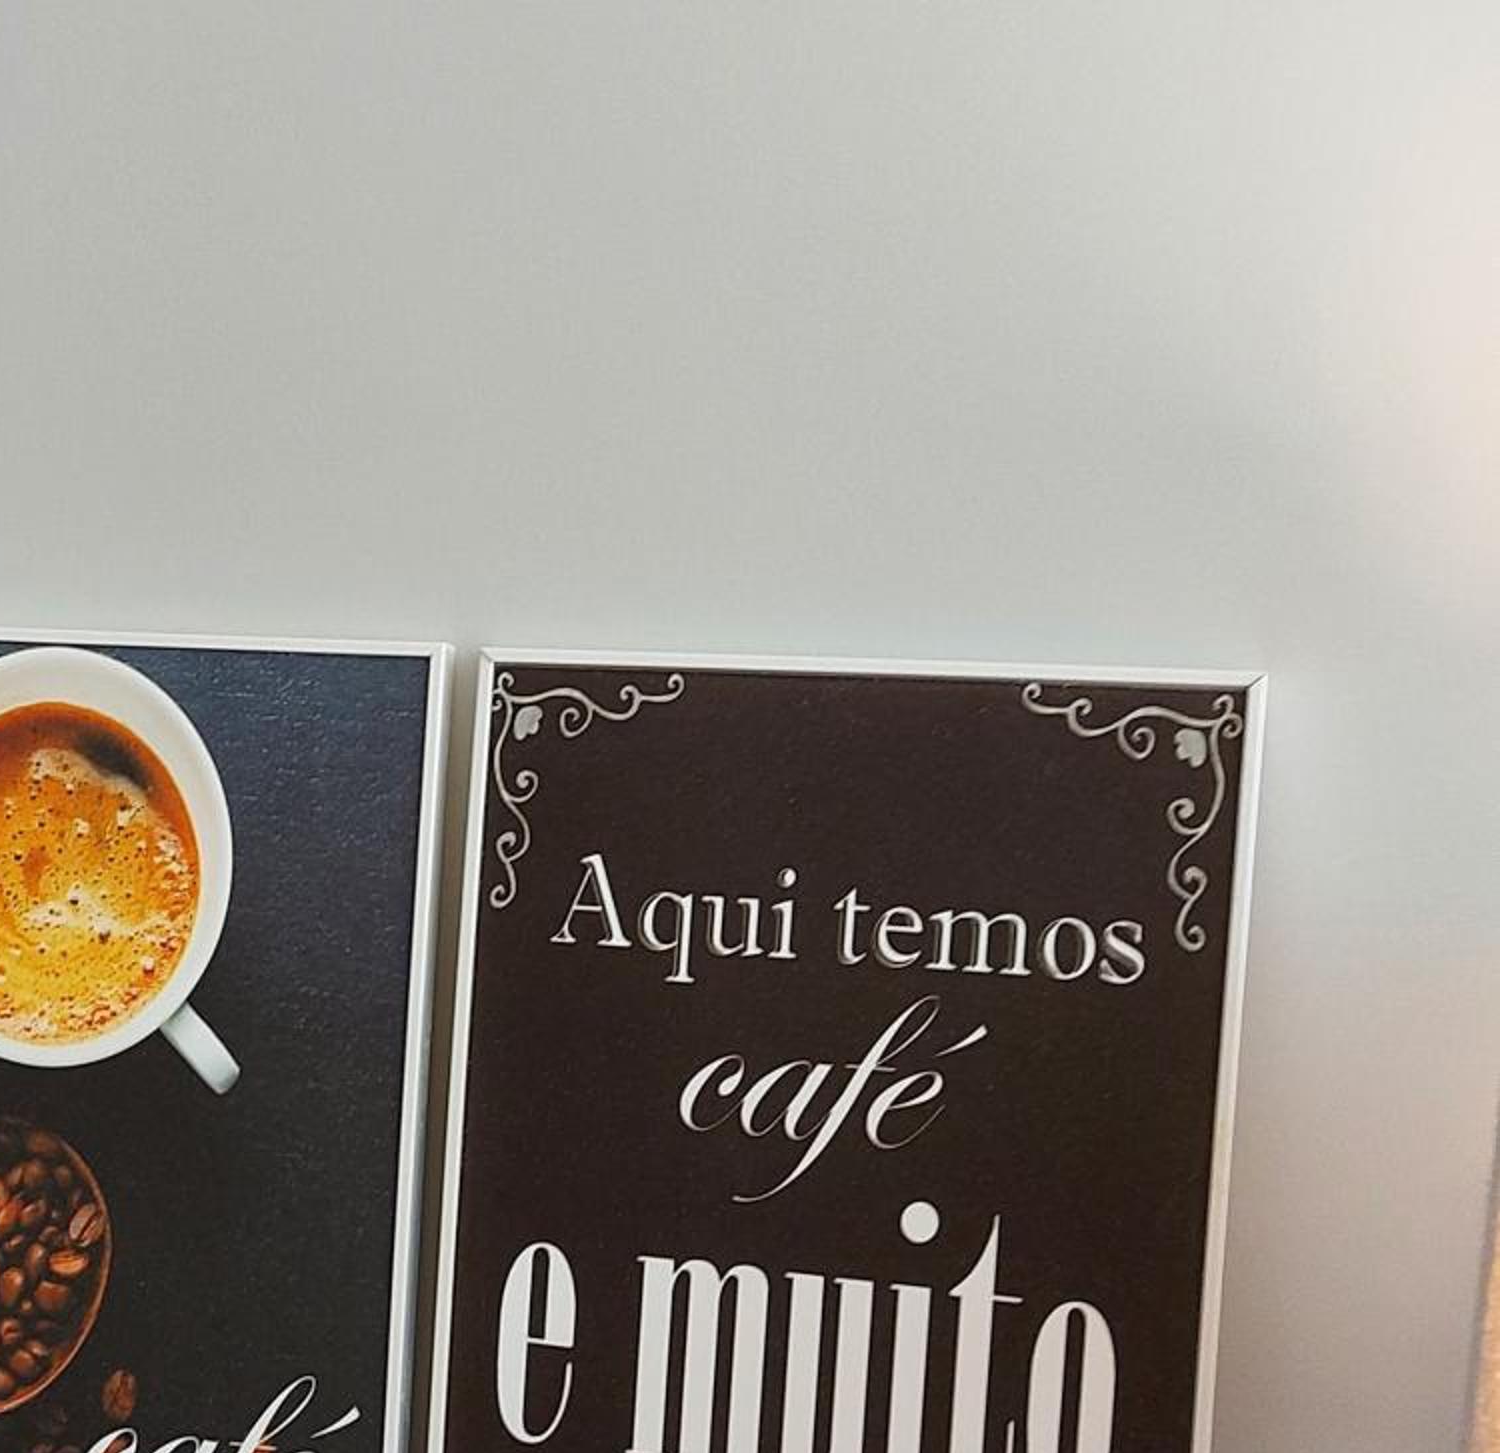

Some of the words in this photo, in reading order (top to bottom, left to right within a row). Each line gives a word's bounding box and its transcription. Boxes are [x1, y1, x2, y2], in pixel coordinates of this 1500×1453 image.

[550, 853, 797, 984] Aqui
[833, 887, 1146, 985] temos
[679, 995, 988, 1202] café
[498, 1242, 577, 1444] e
